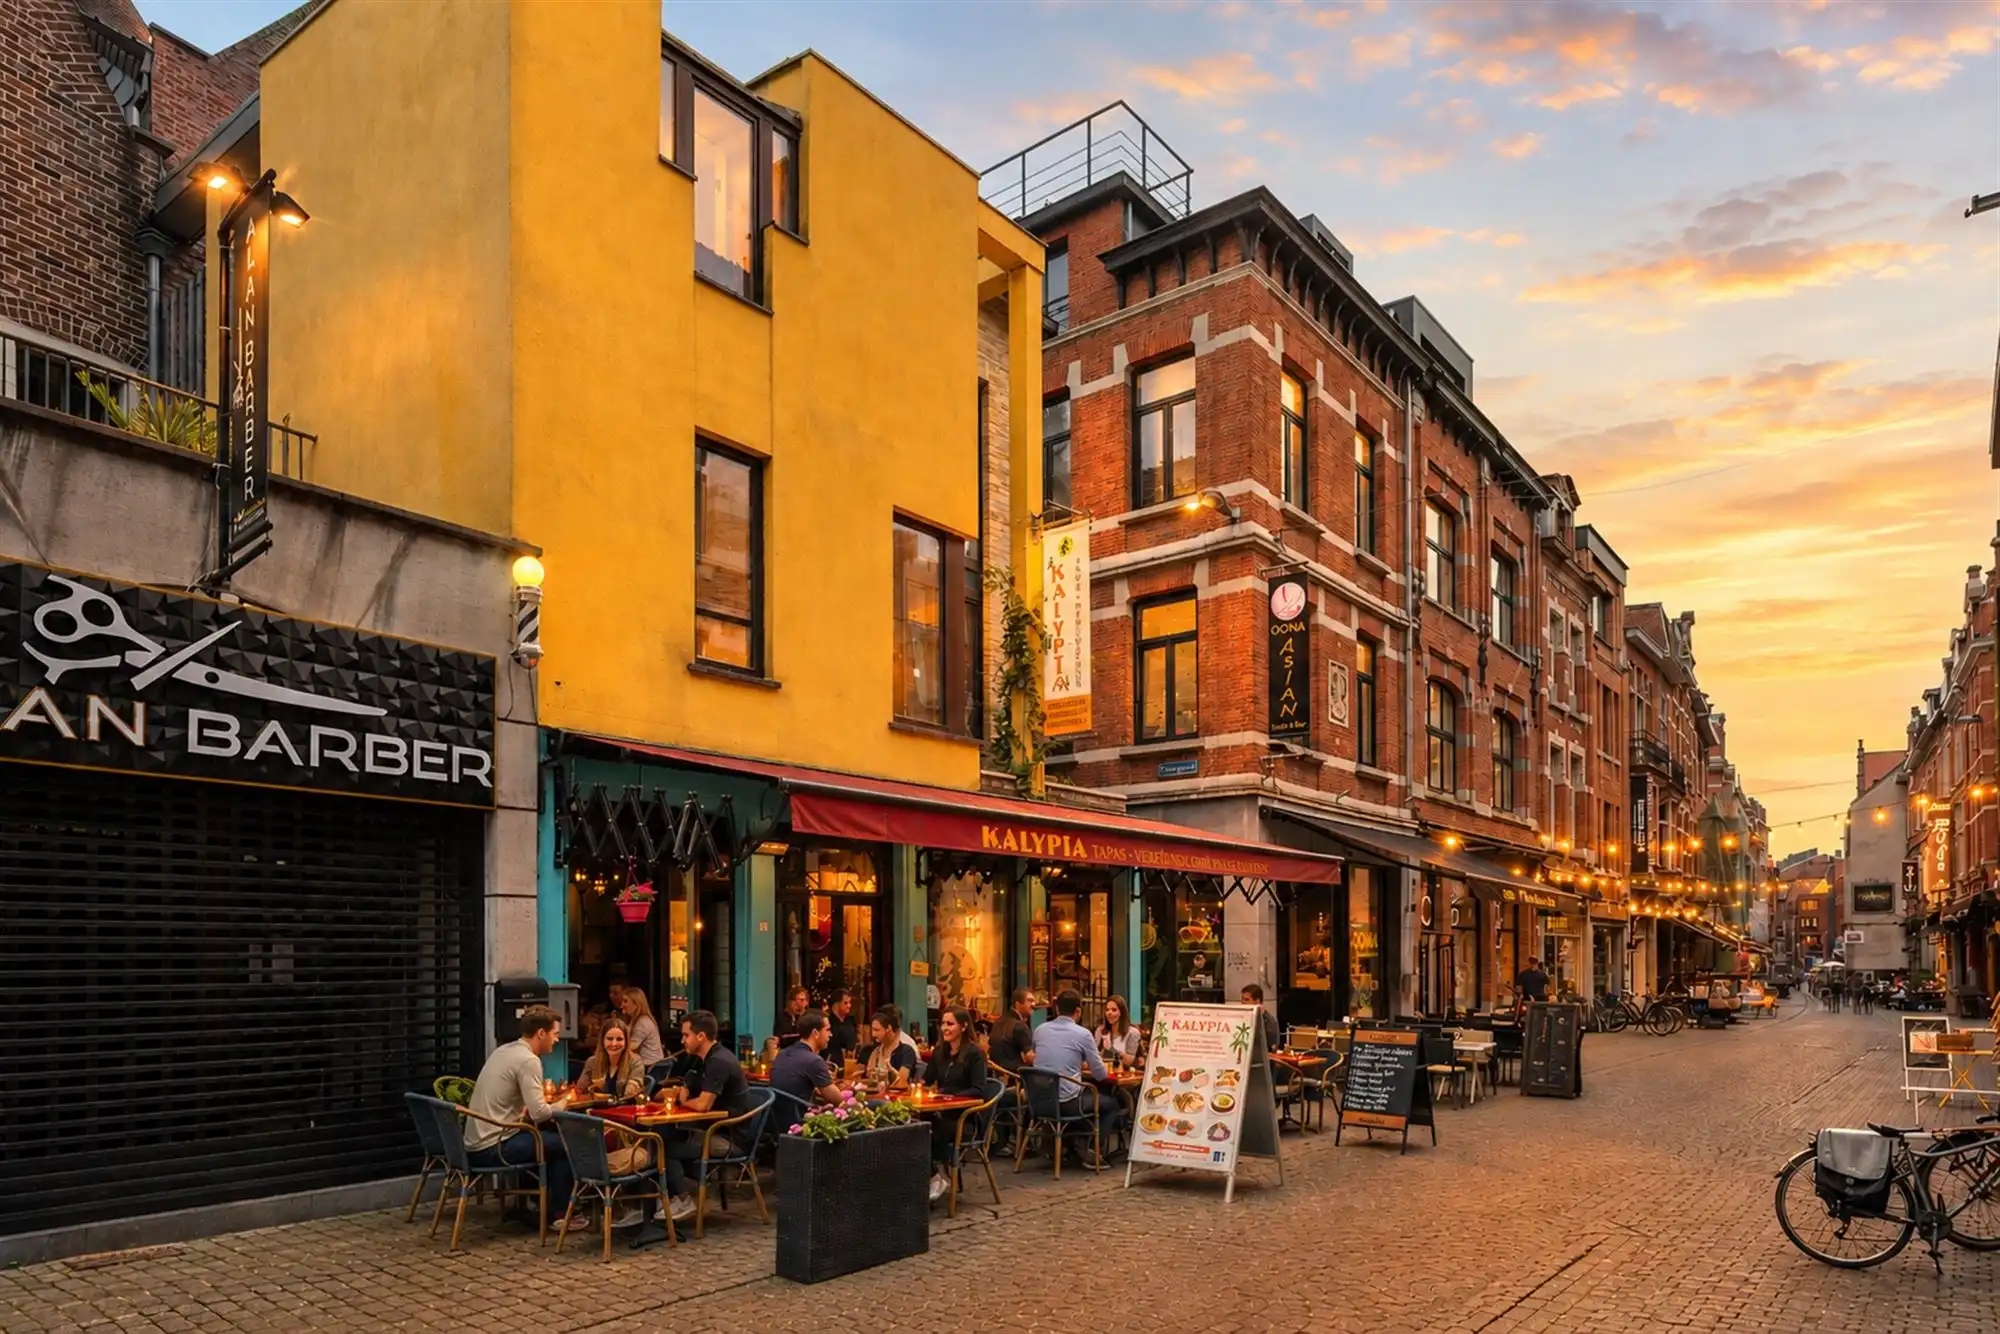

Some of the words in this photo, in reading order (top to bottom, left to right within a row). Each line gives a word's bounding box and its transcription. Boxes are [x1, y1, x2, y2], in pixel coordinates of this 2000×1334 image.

[245, 216, 256, 331] ALAN
[244, 339, 255, 501] BARBER
[1271, 621, 1306, 635] OONA
[1279, 637, 1298, 717] ASIAN
[0, 686, 146, 747] AN
[188, 707, 493, 789] BARBER
[982, 825, 1088, 859] KALYPIA
[1091, 844, 1128, 862] TAPAS
[1171, 1020, 1231, 1034] KALYPIA
